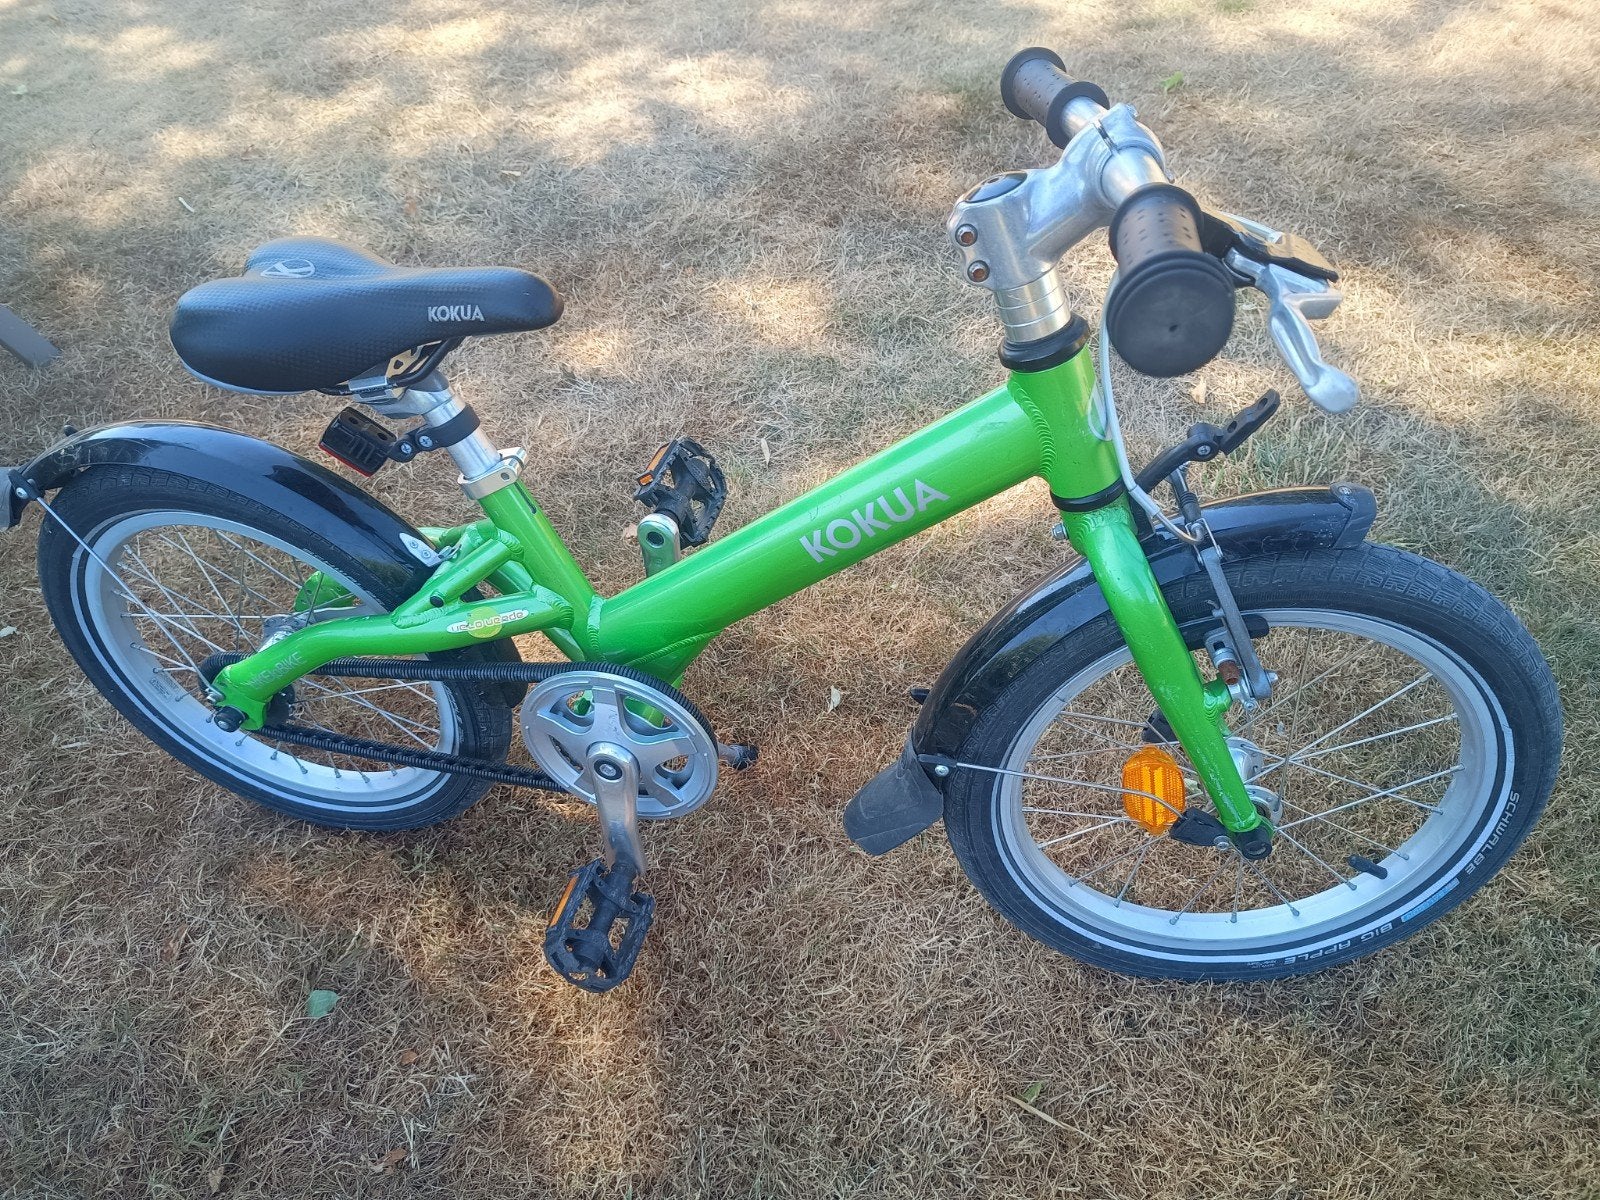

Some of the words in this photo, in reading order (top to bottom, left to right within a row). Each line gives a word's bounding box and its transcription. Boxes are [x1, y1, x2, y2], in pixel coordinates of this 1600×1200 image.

[428, 304, 485, 322] KOKUA
[799, 479, 950, 563] KOKUA
[1464, 791, 1520, 875] SCHWALBE
[1360, 922, 1393, 942] BIG
[1284, 940, 1351, 965] APPLE
